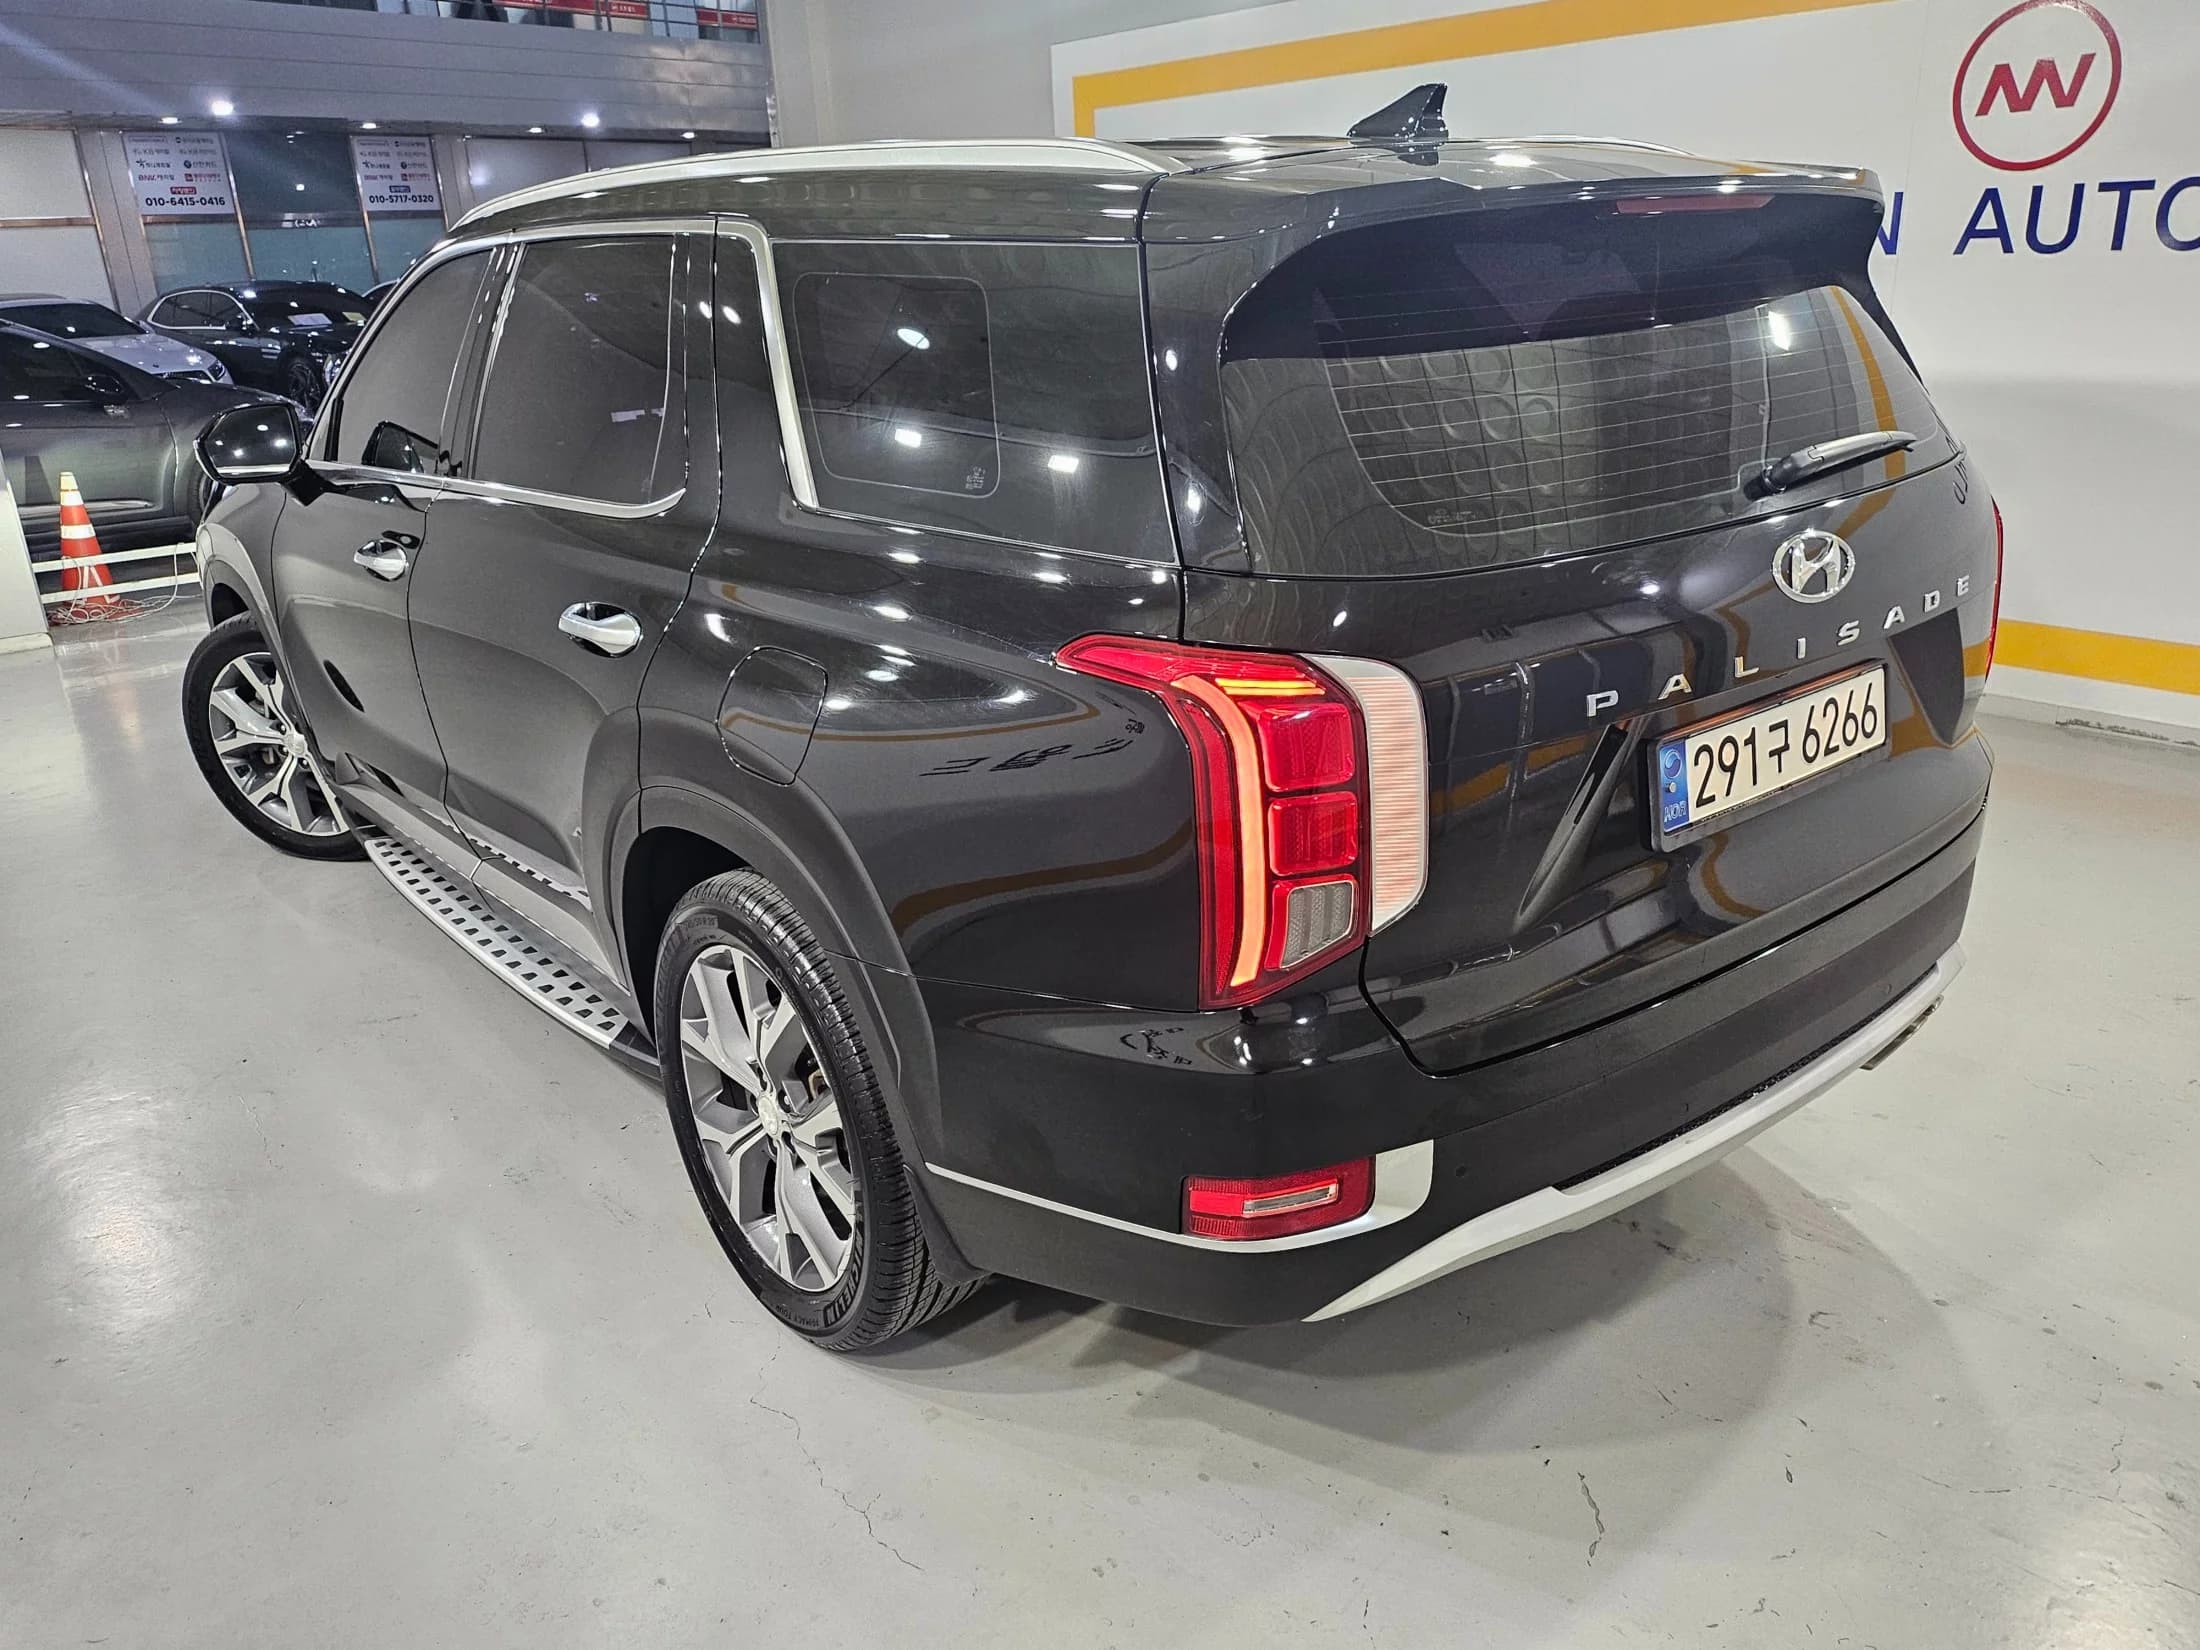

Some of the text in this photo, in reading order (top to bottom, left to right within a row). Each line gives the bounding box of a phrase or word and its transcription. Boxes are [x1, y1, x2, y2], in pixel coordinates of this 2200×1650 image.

[145, 196, 226, 207] 010-6415-0416
[368, 195, 434, 204] 010-5717-0320
[1952, 175, 2200, 255] AUTO
[1586, 575, 1970, 717] PALISADE
[1693, 682, 1878, 809] 291구 6266
